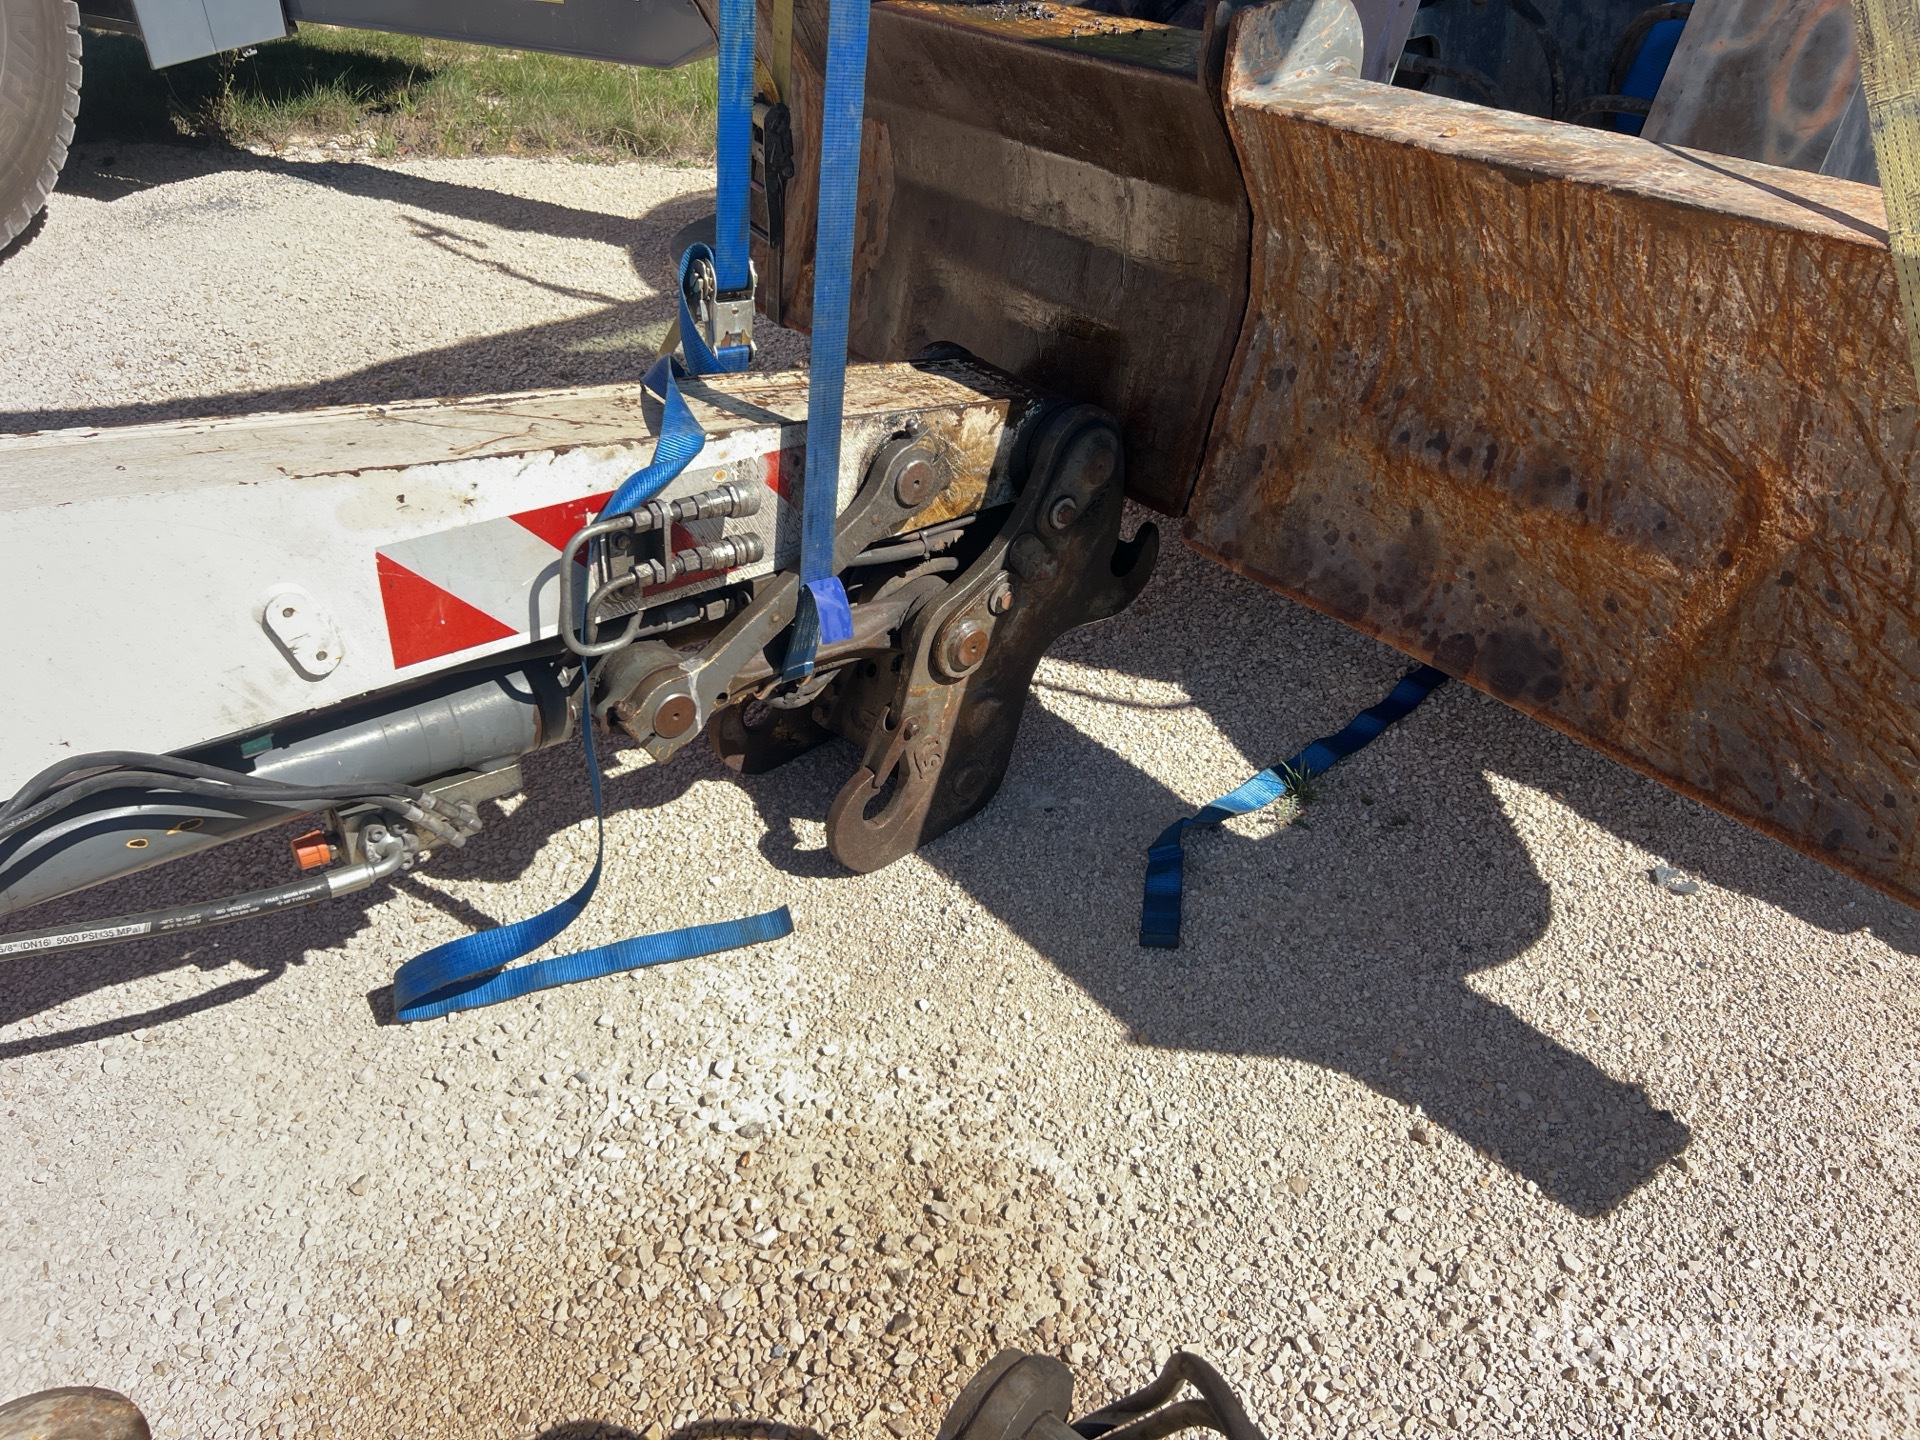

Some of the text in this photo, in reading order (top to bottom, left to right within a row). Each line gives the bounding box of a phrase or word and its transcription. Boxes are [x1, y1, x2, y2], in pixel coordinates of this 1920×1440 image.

[20, 938, 52, 950] (DN16)
[57, 934, 79, 945] 5000
[82, 931, 98, 941] PSI
[117, 925, 141, 936] MPa)
